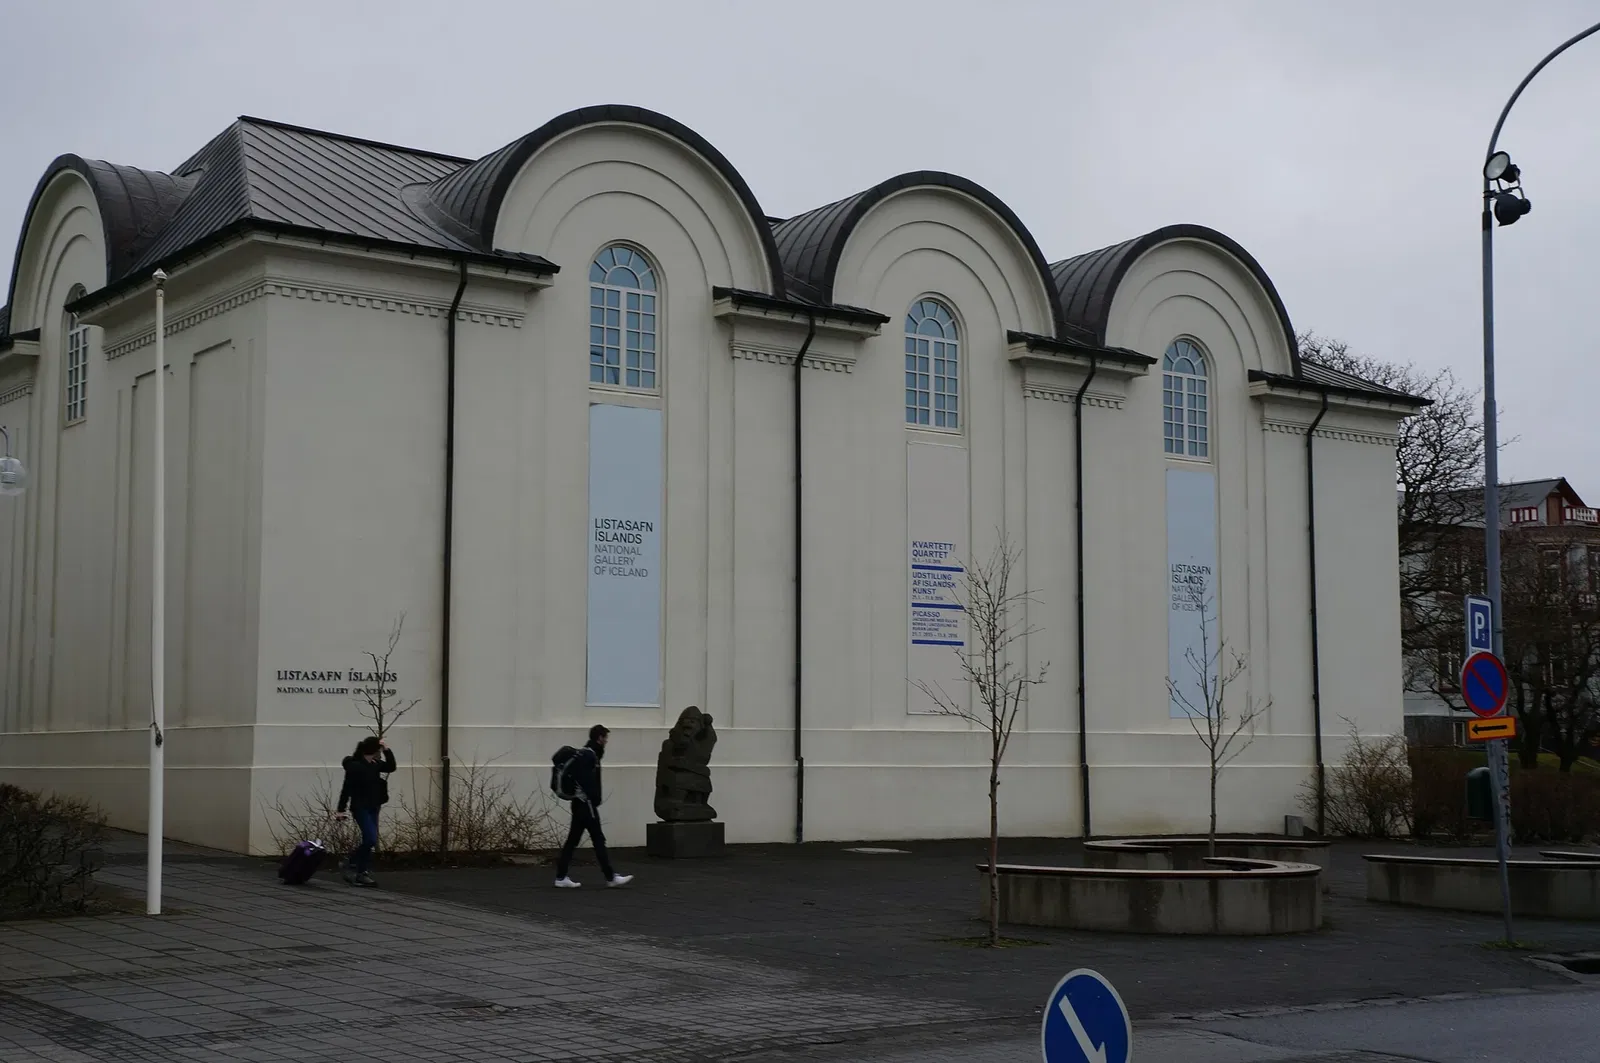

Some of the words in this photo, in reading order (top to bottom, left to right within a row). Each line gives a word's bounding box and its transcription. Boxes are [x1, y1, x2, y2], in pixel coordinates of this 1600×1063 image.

[594, 518, 653, 532] LISTASAFN
[594, 528, 643, 544] ÍSLANDS
[594, 544, 642, 556] NATIONAL
[912, 549, 948, 559] QUARTET
[594, 555, 635, 566] GALLERY
[594, 566, 606, 576] OF
[608, 566, 648, 578] ICELAND
[1171, 563, 1211, 575] LISTASAFN
[912, 572, 952, 581] UDSTILLING
[1171, 585, 1204, 595] NATINA
[1182, 604, 1208, 612] ICELD
[1474, 611, 1485, 640] P
[277, 670, 342, 681] LISTASAFN
[348, 667, 398, 682] ÍSLANDS
[317, 687, 349, 695] GALLERY
